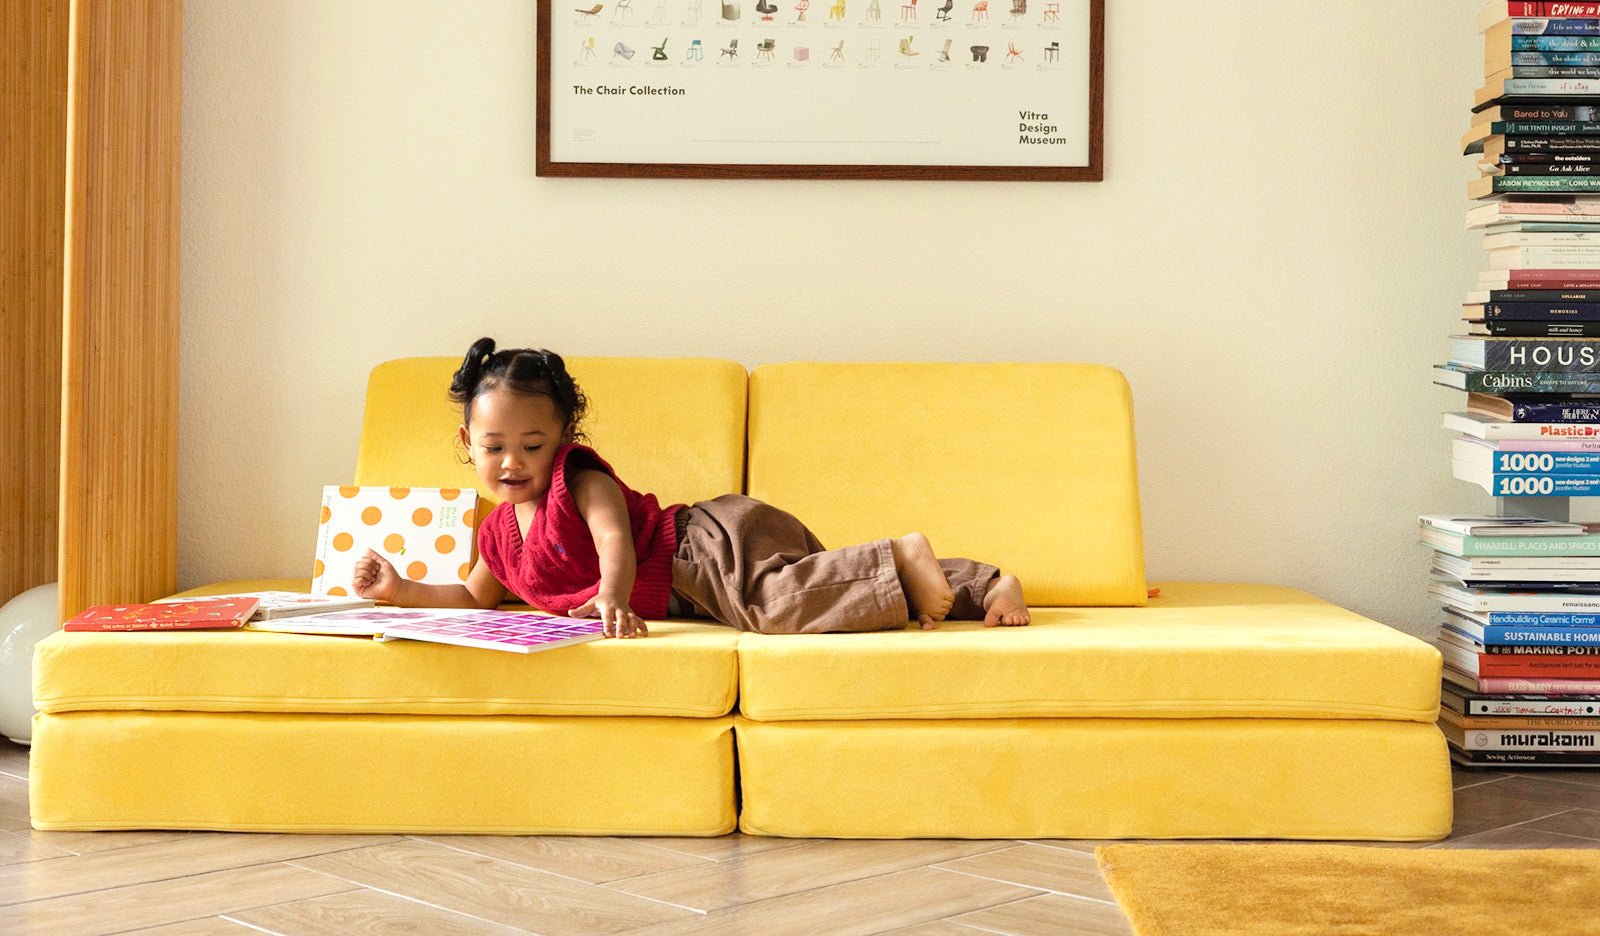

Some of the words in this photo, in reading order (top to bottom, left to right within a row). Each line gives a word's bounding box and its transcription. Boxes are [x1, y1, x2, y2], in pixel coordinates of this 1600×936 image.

[1551, 4, 1584, 15] CRYING
[573, 86, 593, 95] The
[596, 86, 627, 95] Chair
[629, 86, 686, 95] Collection
[1575, 82, 1588, 92] stay
[1019, 111, 1048, 120] Vitra
[1019, 123, 1057, 134] Design
[1019, 135, 1066, 144] Museum
[1510, 346, 1595, 365] HOUS
[1482, 374, 1532, 387] Cabins
[1500, 454, 1554, 471] 1000
[1500, 477, 1554, 494] 1000
[1475, 542, 1516, 550] PHARRELL:
[1518, 542, 1547, 550] PLACES
[1550, 542, 1567, 550] AND
[1569, 542, 1595, 550] SPACES
[1490, 616, 1538, 625] Handbuilding
[1540, 616, 1570, 624] Ceramic
[1504, 633, 1571, 641] SUSTAINABLE
[1508, 682, 1526, 691] BUGS
[1528, 682, 1551, 691] BUNNY
[1545, 705, 1584, 714] Contact
[1501, 732, 1594, 746] murakami
